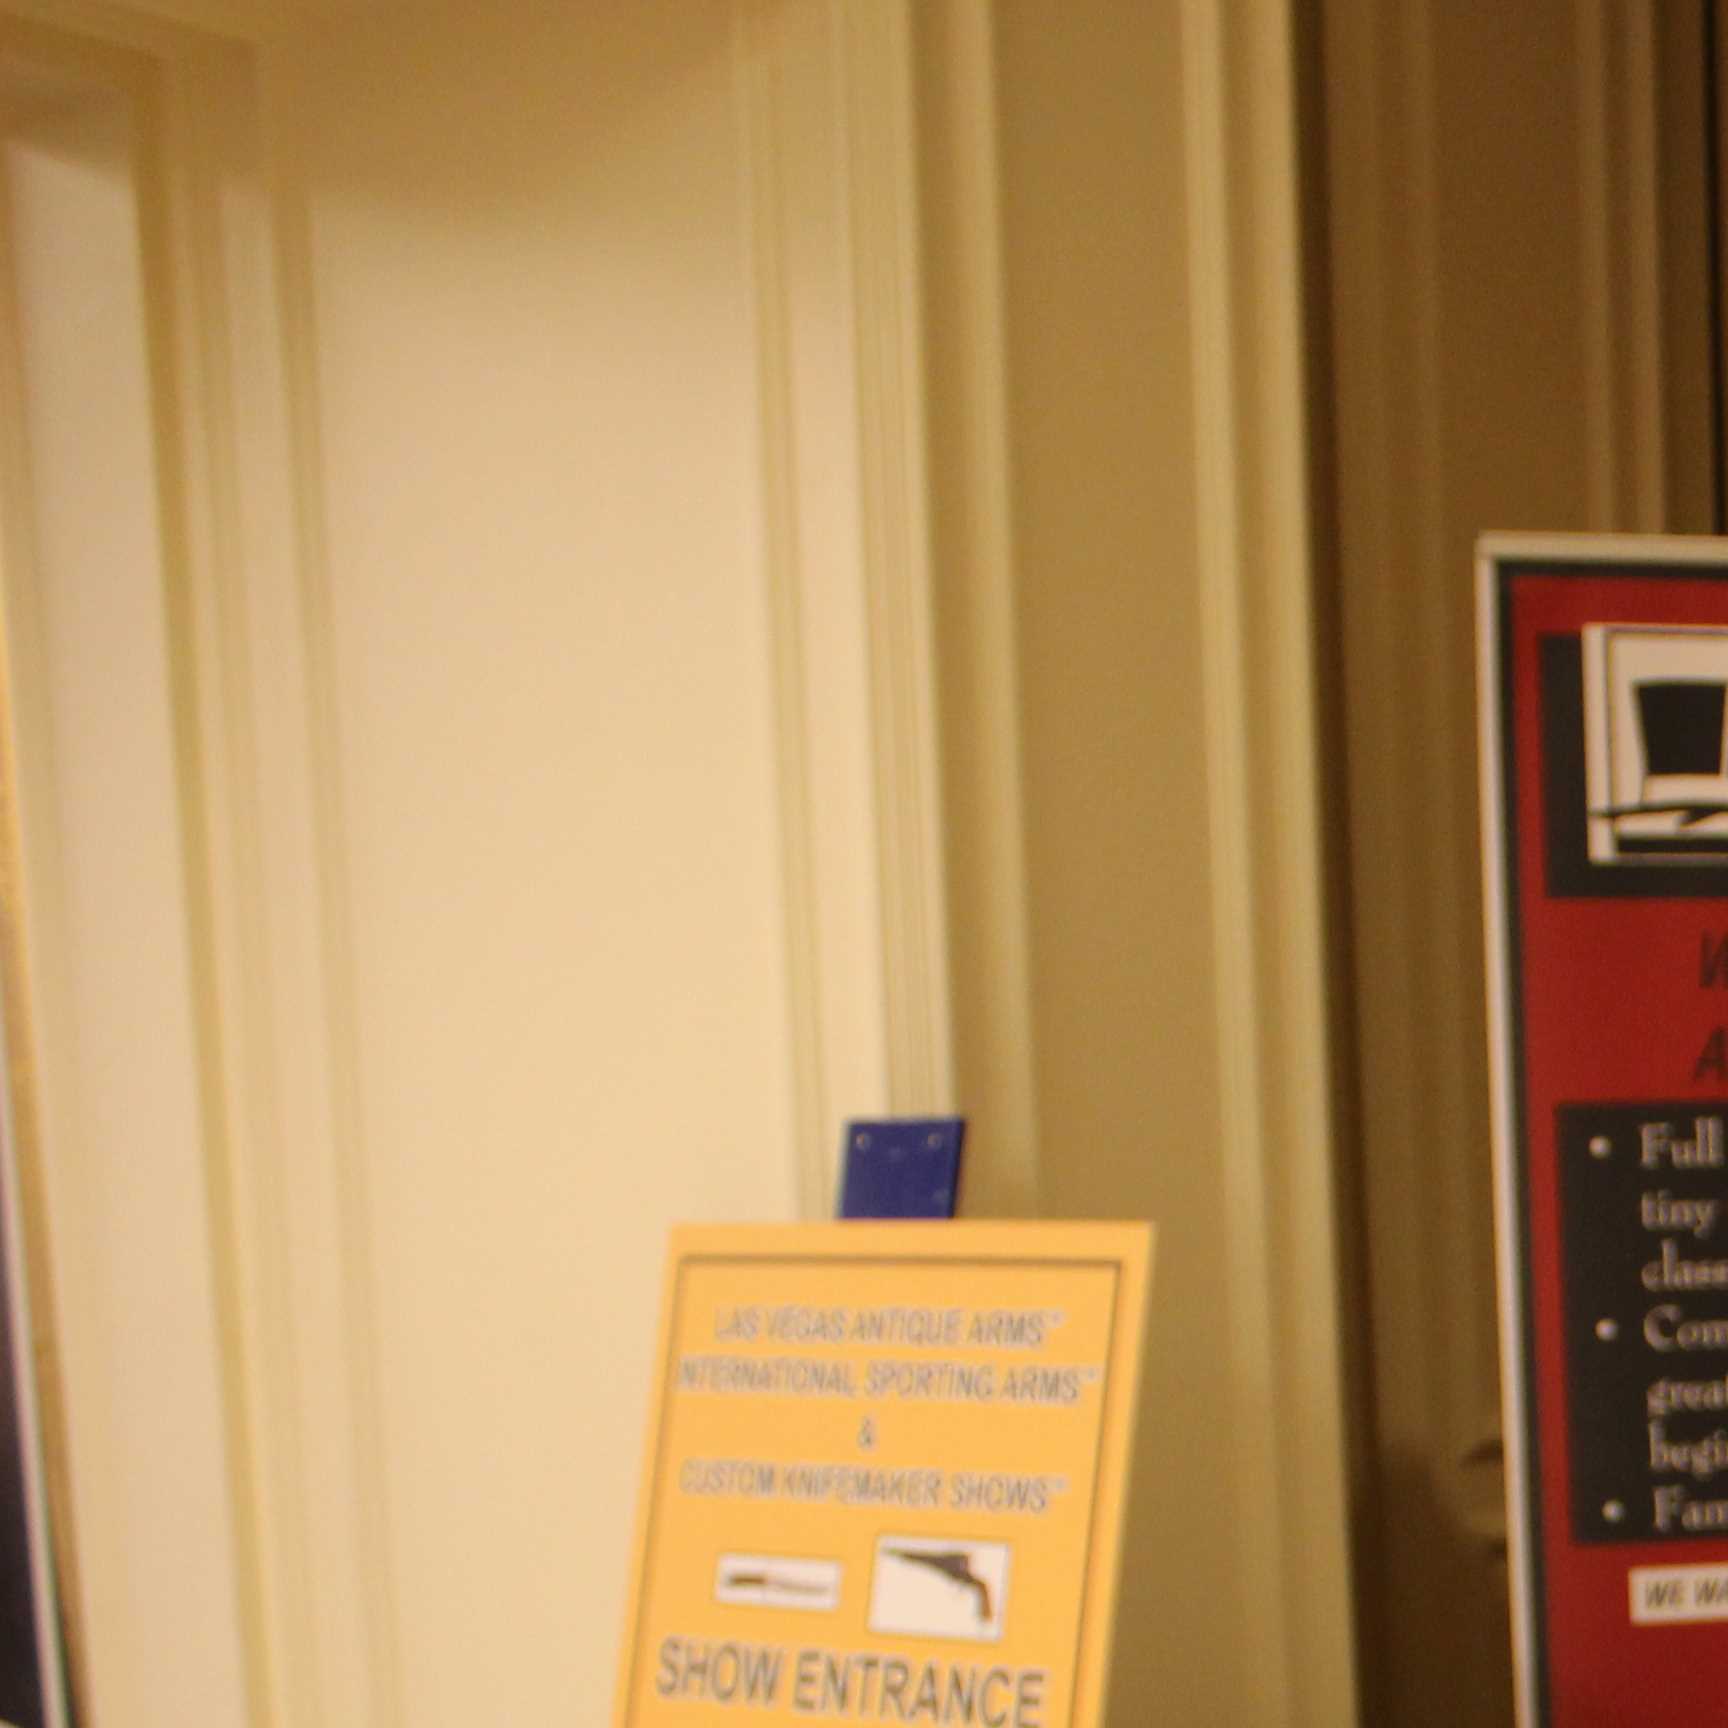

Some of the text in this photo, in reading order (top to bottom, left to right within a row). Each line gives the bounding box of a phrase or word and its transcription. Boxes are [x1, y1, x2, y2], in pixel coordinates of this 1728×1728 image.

[1640, 1116, 1723, 1168] Full
[1641, 1190, 1717, 1236] tiny
[714, 1309, 761, 1341] LAS
[767, 1309, 846, 1342] VEGAS
[850, 1310, 963, 1345] ANTIQUE
[866, 1364, 997, 1400] SPORTING
[857, 1413, 876, 1451] &
[679, 1461, 776, 1497] CUSTOM
[781, 1465, 942, 1508] KNIFEMAKER
[1644, 1579, 1684, 1610] WE
[657, 1637, 786, 1708] SHOW
